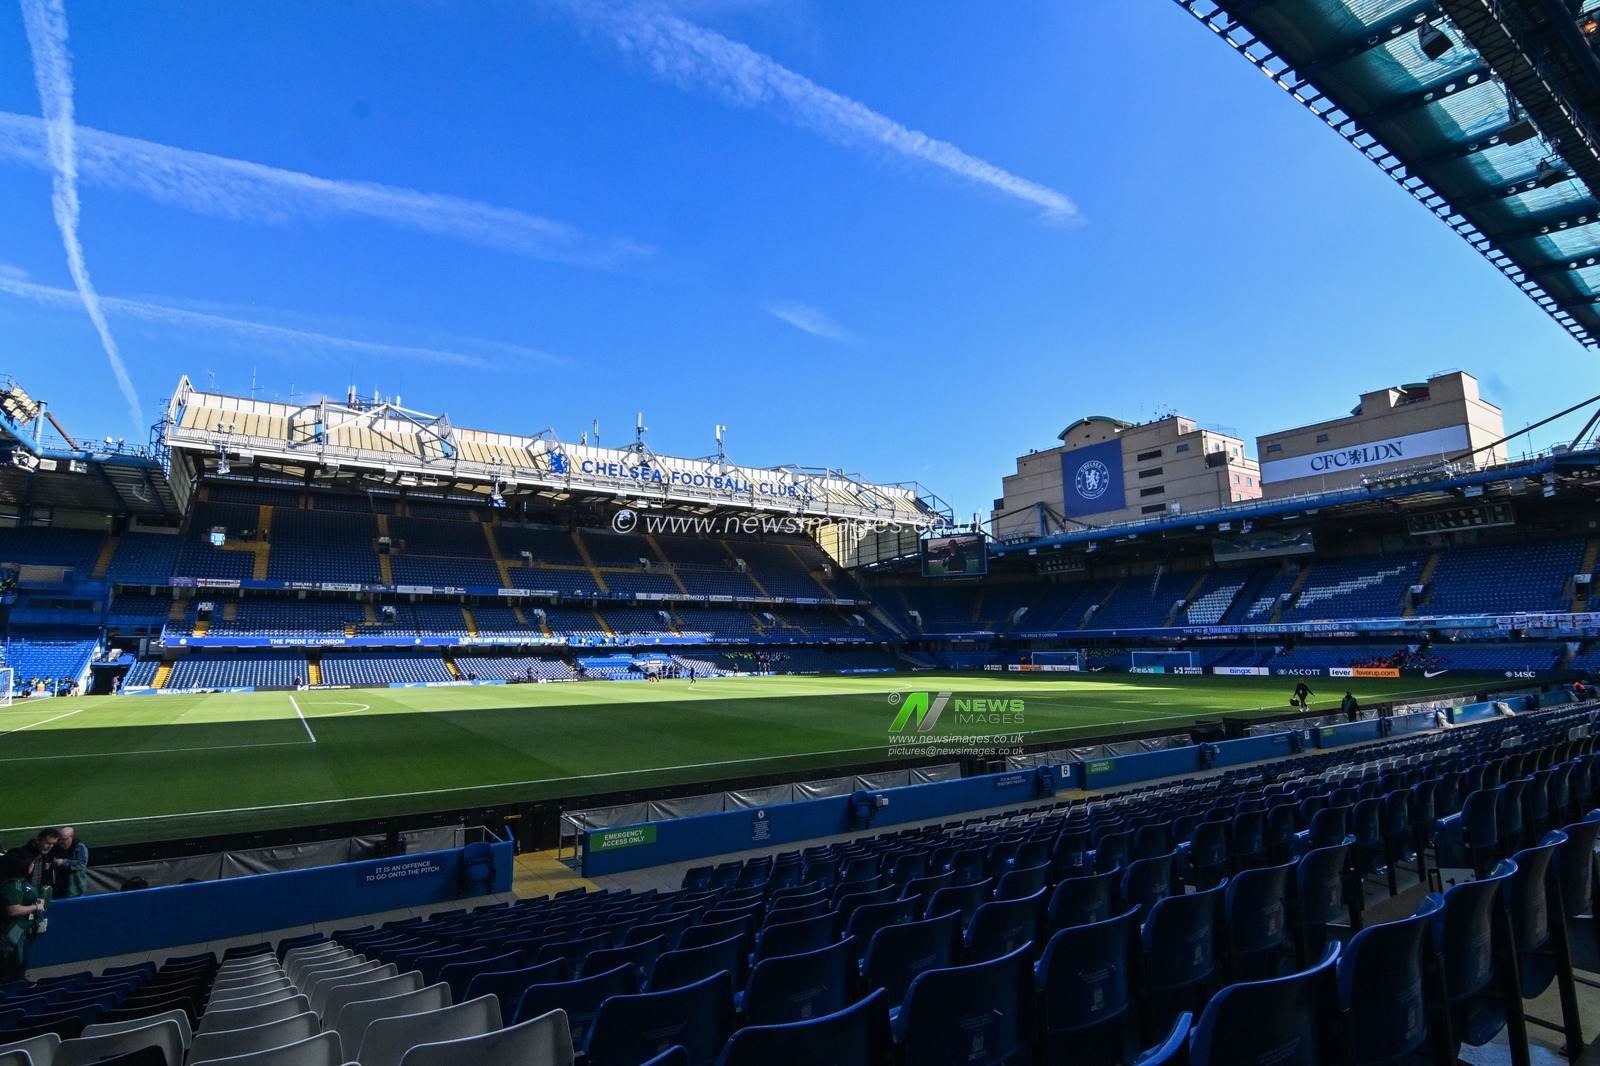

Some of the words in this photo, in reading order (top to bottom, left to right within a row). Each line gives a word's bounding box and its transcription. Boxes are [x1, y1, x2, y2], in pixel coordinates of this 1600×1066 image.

[1310, 453, 1349, 471] CFC
[1362, 441, 1404, 464] LDN
[1080, 462, 1102, 472] CHELSEA
[581, 460, 662, 482] CHELSEA
[671, 472, 750, 492] FOOTBALL
[759, 482, 797, 497] CLUB
[1288, 668, 1321, 676] ASCOTT
[1331, 668, 1351, 676] fever
[1356, 668, 1396, 677] feverup.com
[1513, 670, 1536, 678] MSC
[604, 829, 644, 841] EMERGENCY
[602, 837, 628, 848] ACCESS
[629, 835, 645, 843] ONLY
[401, 860, 431, 870] OFFENCE
[387, 871, 407, 879] ONTO
[408, 868, 420, 876] THE
[420, 866, 440, 874] PITCH
